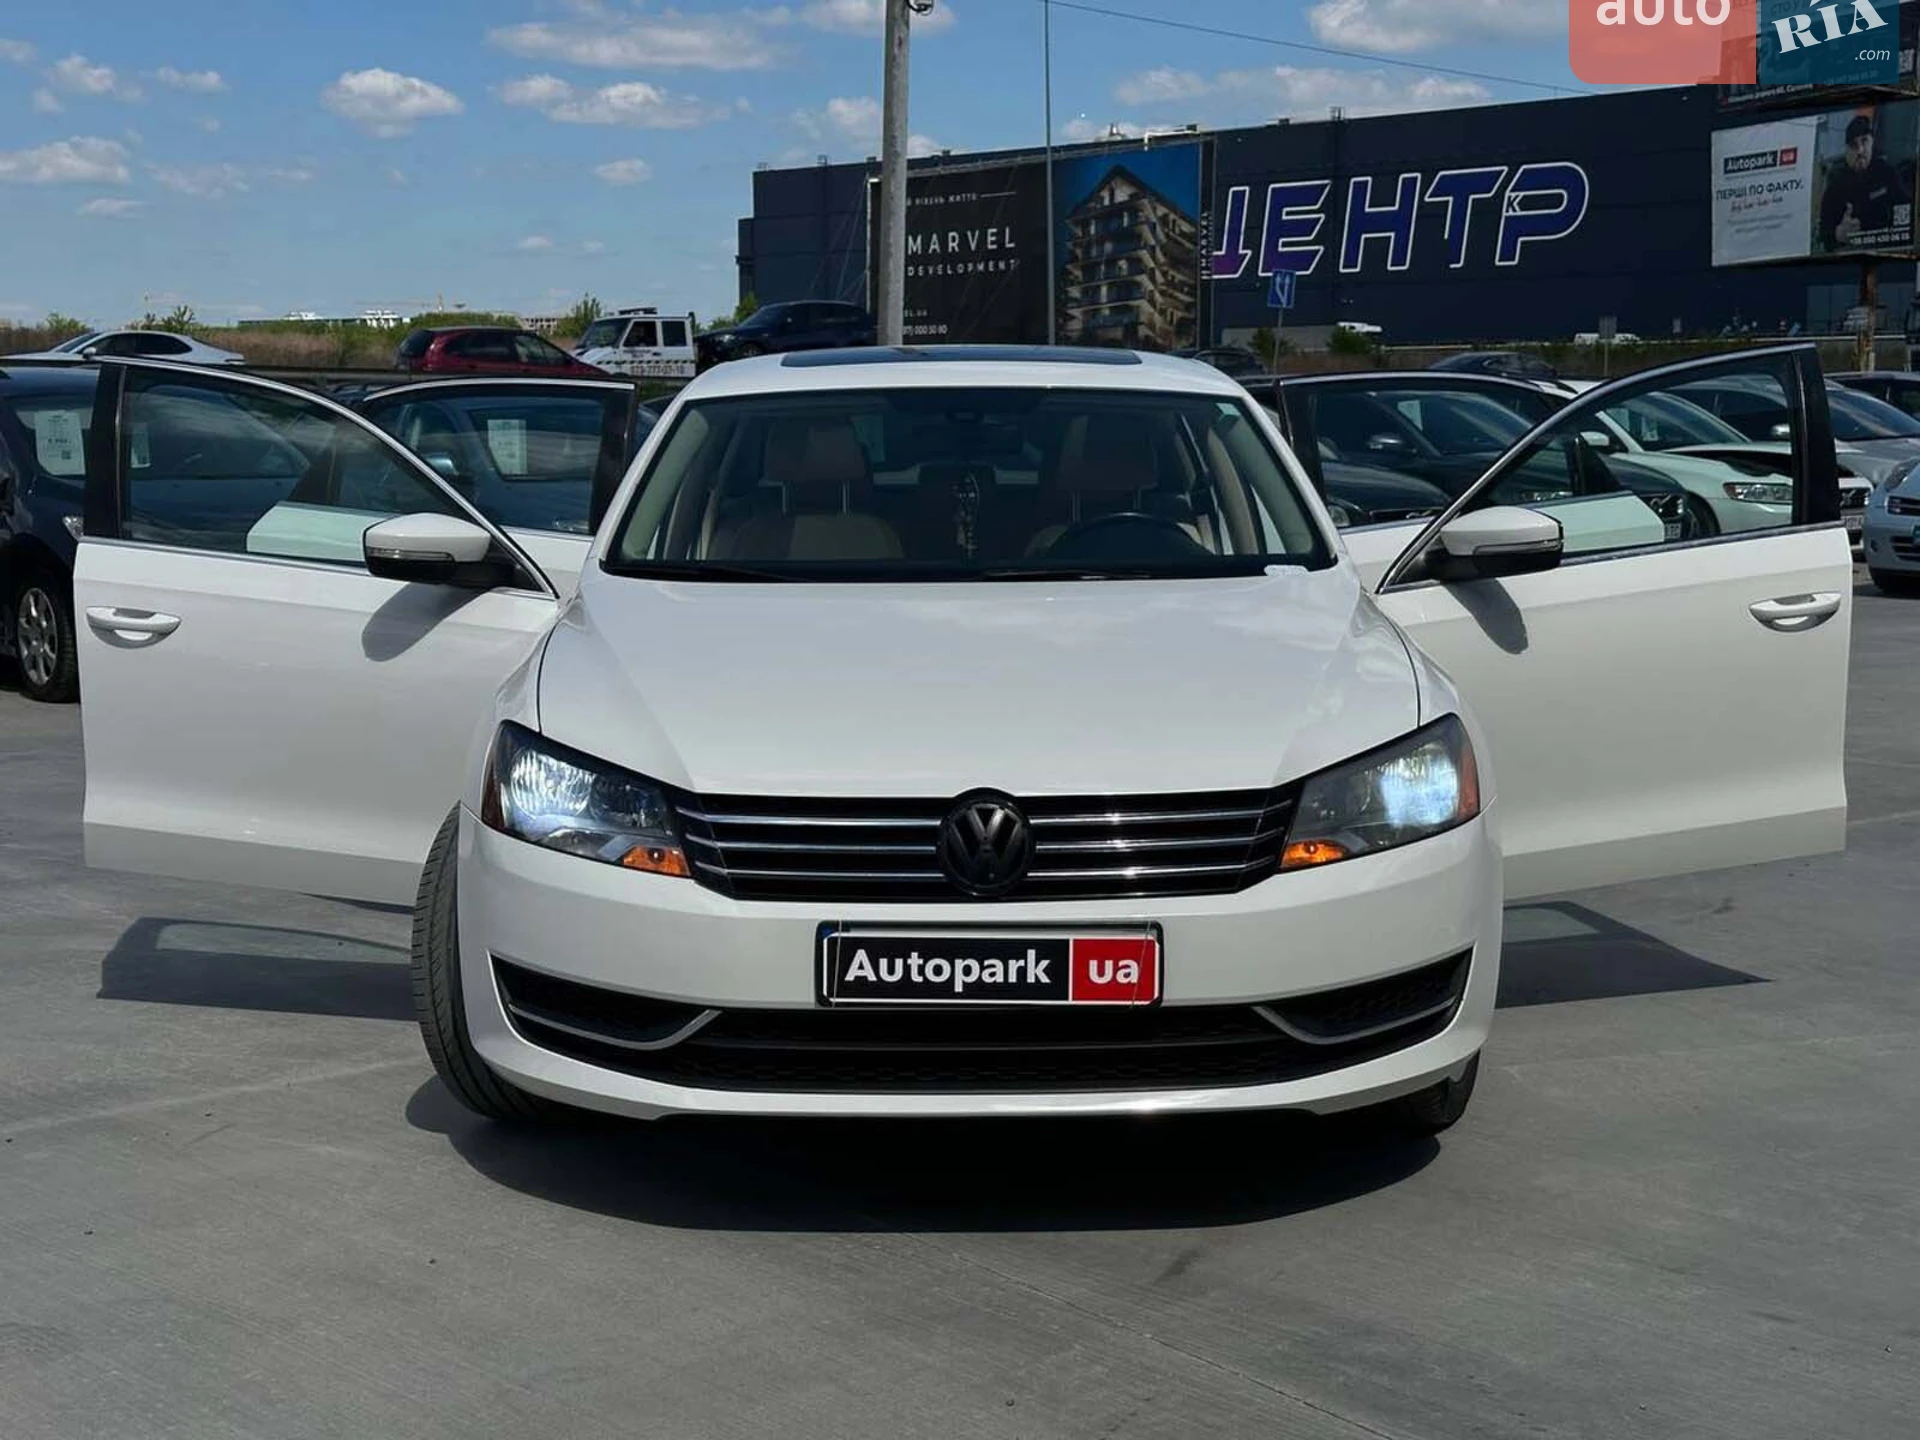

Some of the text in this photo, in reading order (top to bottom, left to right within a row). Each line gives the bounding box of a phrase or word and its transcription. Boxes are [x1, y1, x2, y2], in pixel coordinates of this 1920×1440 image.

[1726, 153, 1774, 171] Autopark
[1749, 183, 1764, 196] ПО
[908, 226, 1016, 255] MARVEL
[907, 259, 1015, 277] DEVELOPMENT
[844, 949, 1138, 992] Autopark ua
